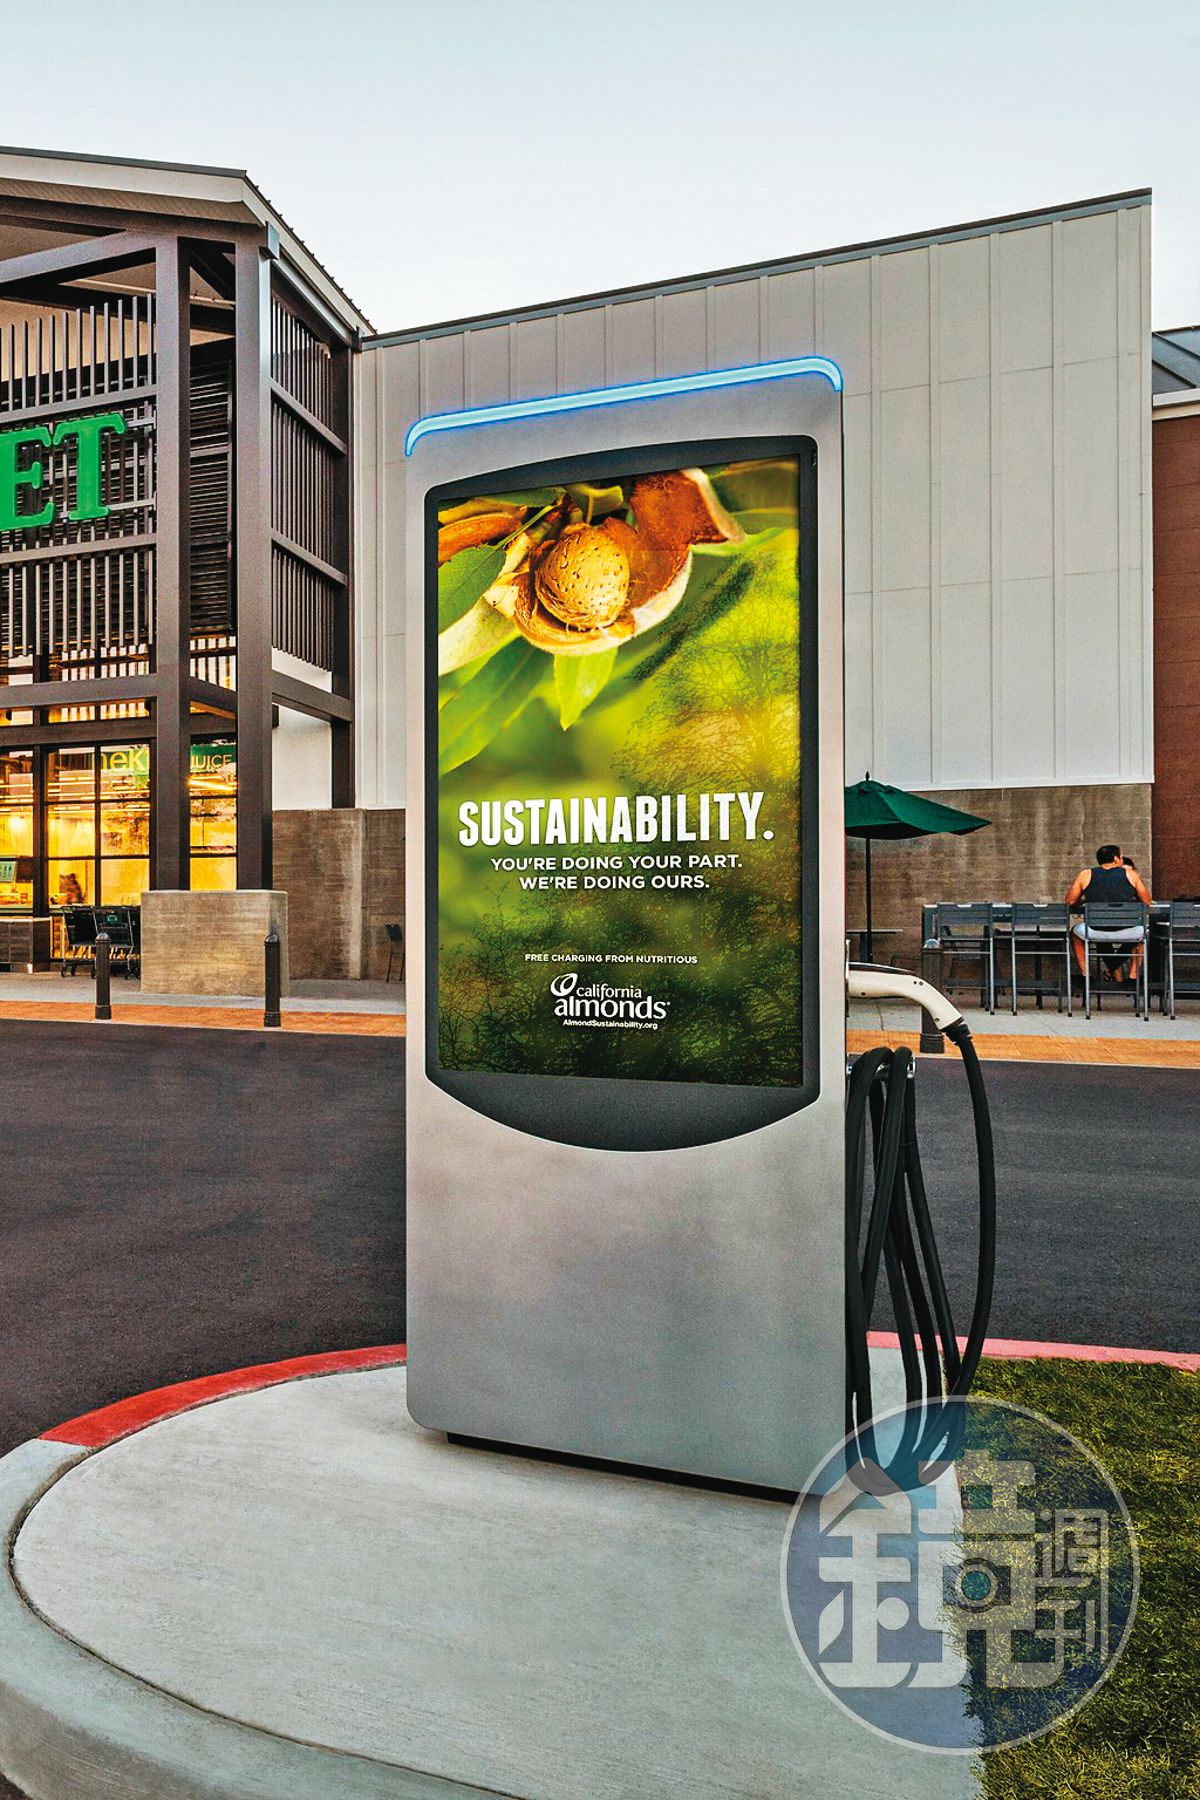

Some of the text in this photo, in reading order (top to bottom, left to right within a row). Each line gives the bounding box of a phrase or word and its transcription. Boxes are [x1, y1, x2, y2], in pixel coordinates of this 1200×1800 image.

[458, 792, 774, 847] SUSTAINABILITY.
[490, 854, 744, 872] YOU'RE DOING YOUR PART.
[519, 875, 711, 890] WE'RE DOING OURS.
[525, 953, 698, 964] FREE CHARGING FROM NUTRITIOUS
[576, 983, 642, 1000] california
[554, 995, 668, 1020] almonds
[562, 1019, 659, 1031] AlmondSustainability.org
